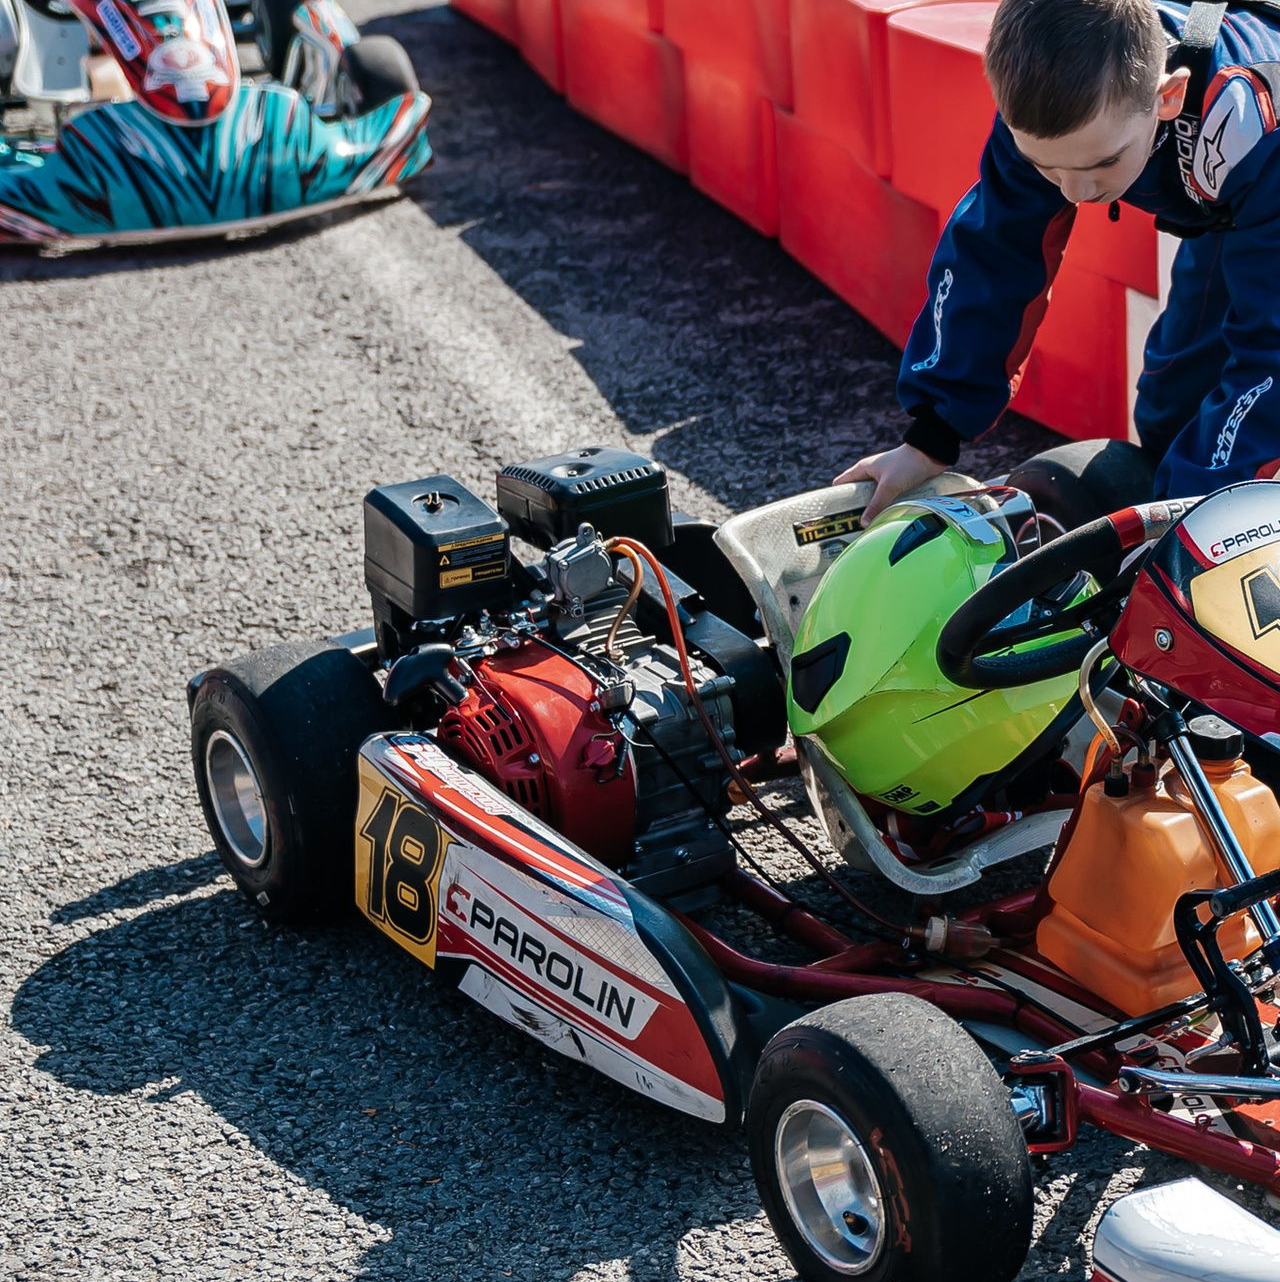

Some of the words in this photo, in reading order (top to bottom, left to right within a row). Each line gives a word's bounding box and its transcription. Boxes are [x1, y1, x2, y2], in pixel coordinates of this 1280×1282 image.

[797, 516, 865, 543] TILLET
[882, 785, 915, 804] OMP
[360, 786, 443, 945] 18
[469, 897, 636, 1029] PAROLIN
